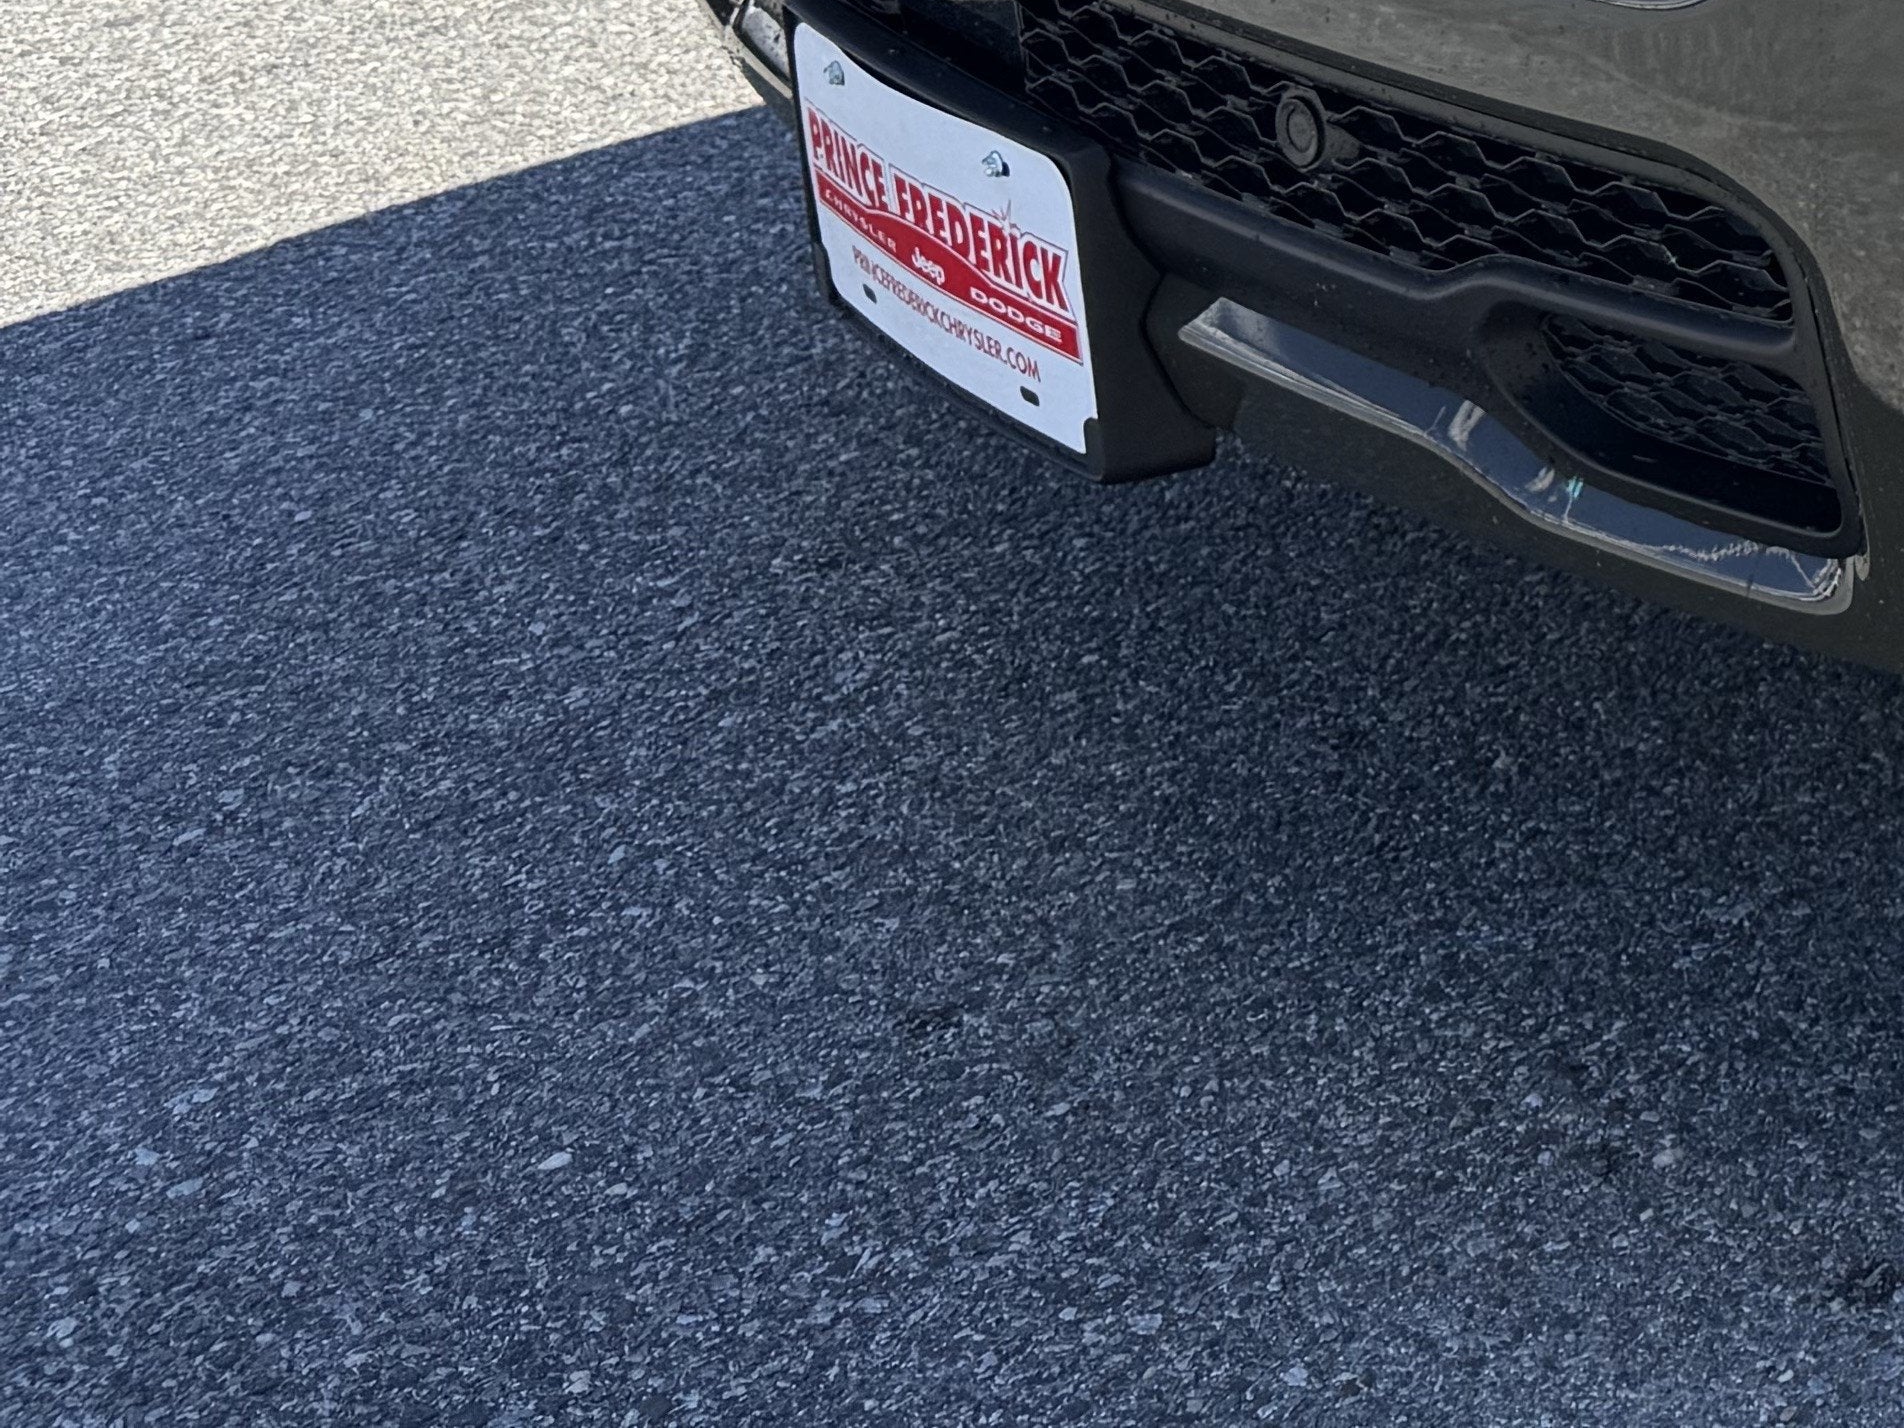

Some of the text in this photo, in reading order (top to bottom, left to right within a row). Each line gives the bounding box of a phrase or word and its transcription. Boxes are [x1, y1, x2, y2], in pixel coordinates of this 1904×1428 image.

[807, 106, 1069, 313] PRINCE FREDERICK
[825, 189, 1063, 344] CHRYSLER Jeep DODGE
[852, 244, 1042, 383] PRINCEFREDERICKCHRYSLER.COM
